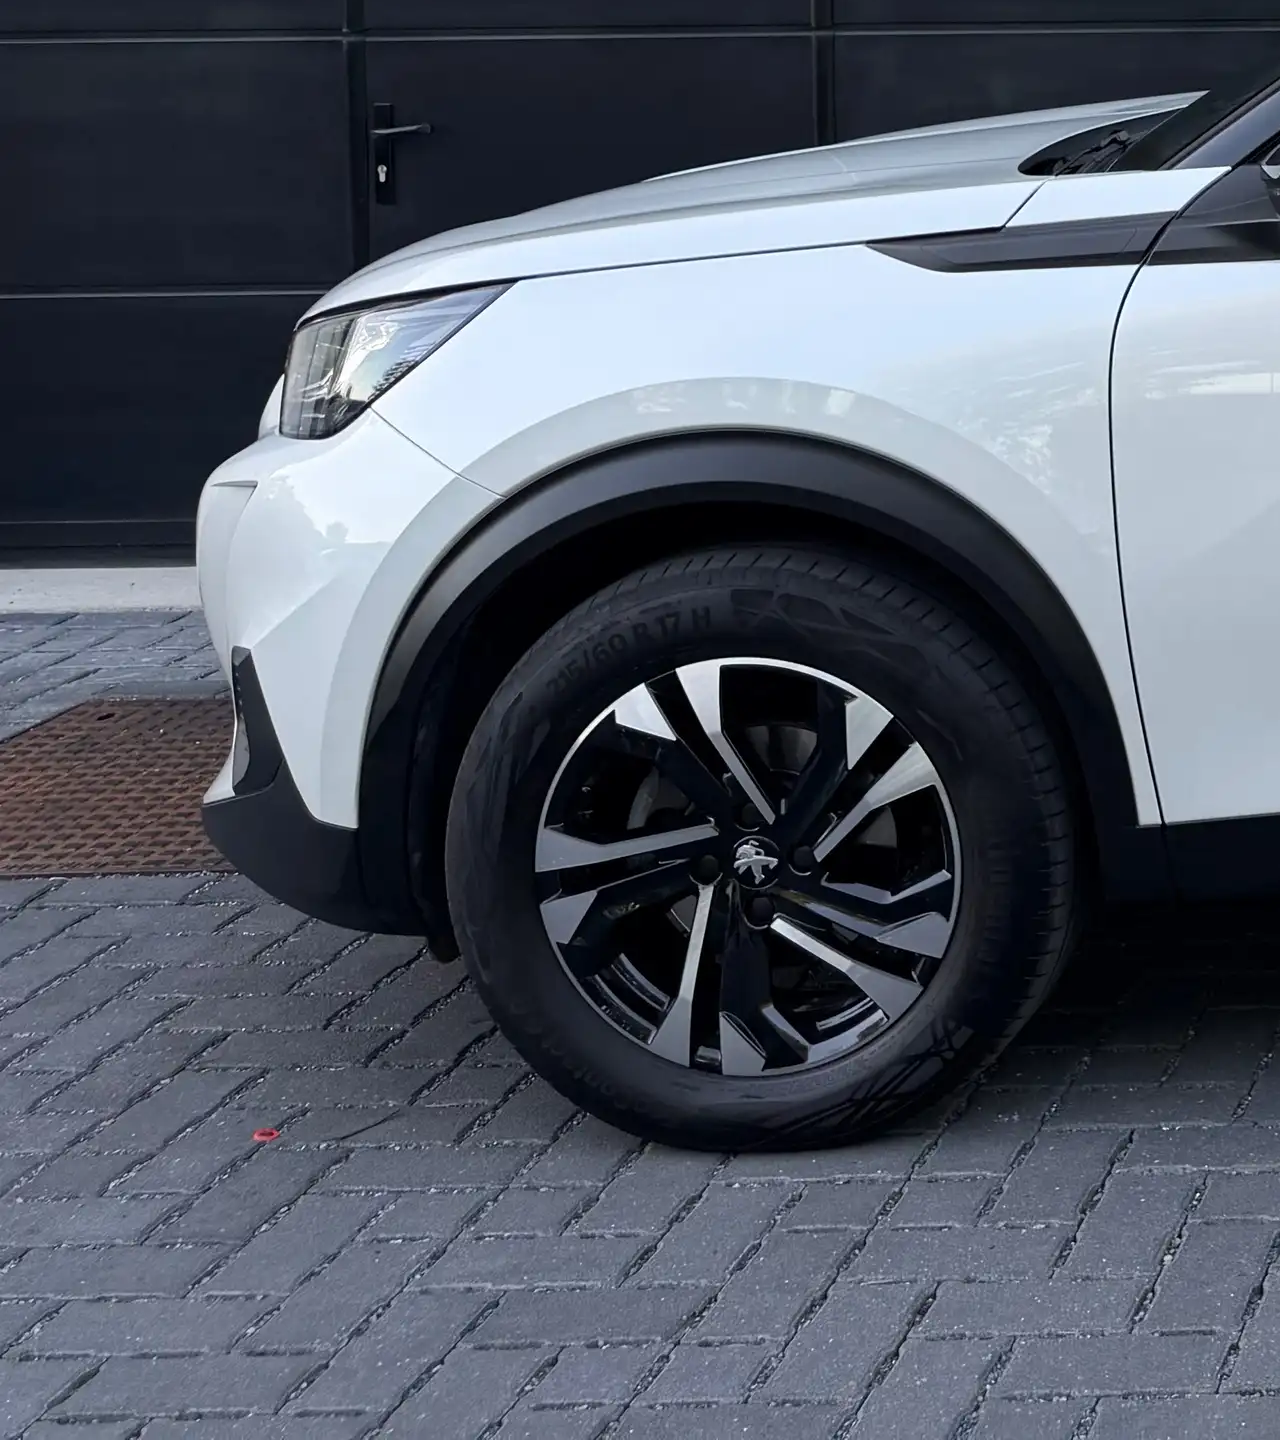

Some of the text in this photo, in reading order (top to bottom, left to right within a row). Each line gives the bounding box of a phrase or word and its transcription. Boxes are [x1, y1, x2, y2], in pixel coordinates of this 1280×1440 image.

[545, 605, 712, 695] 215/60 R 17 H
